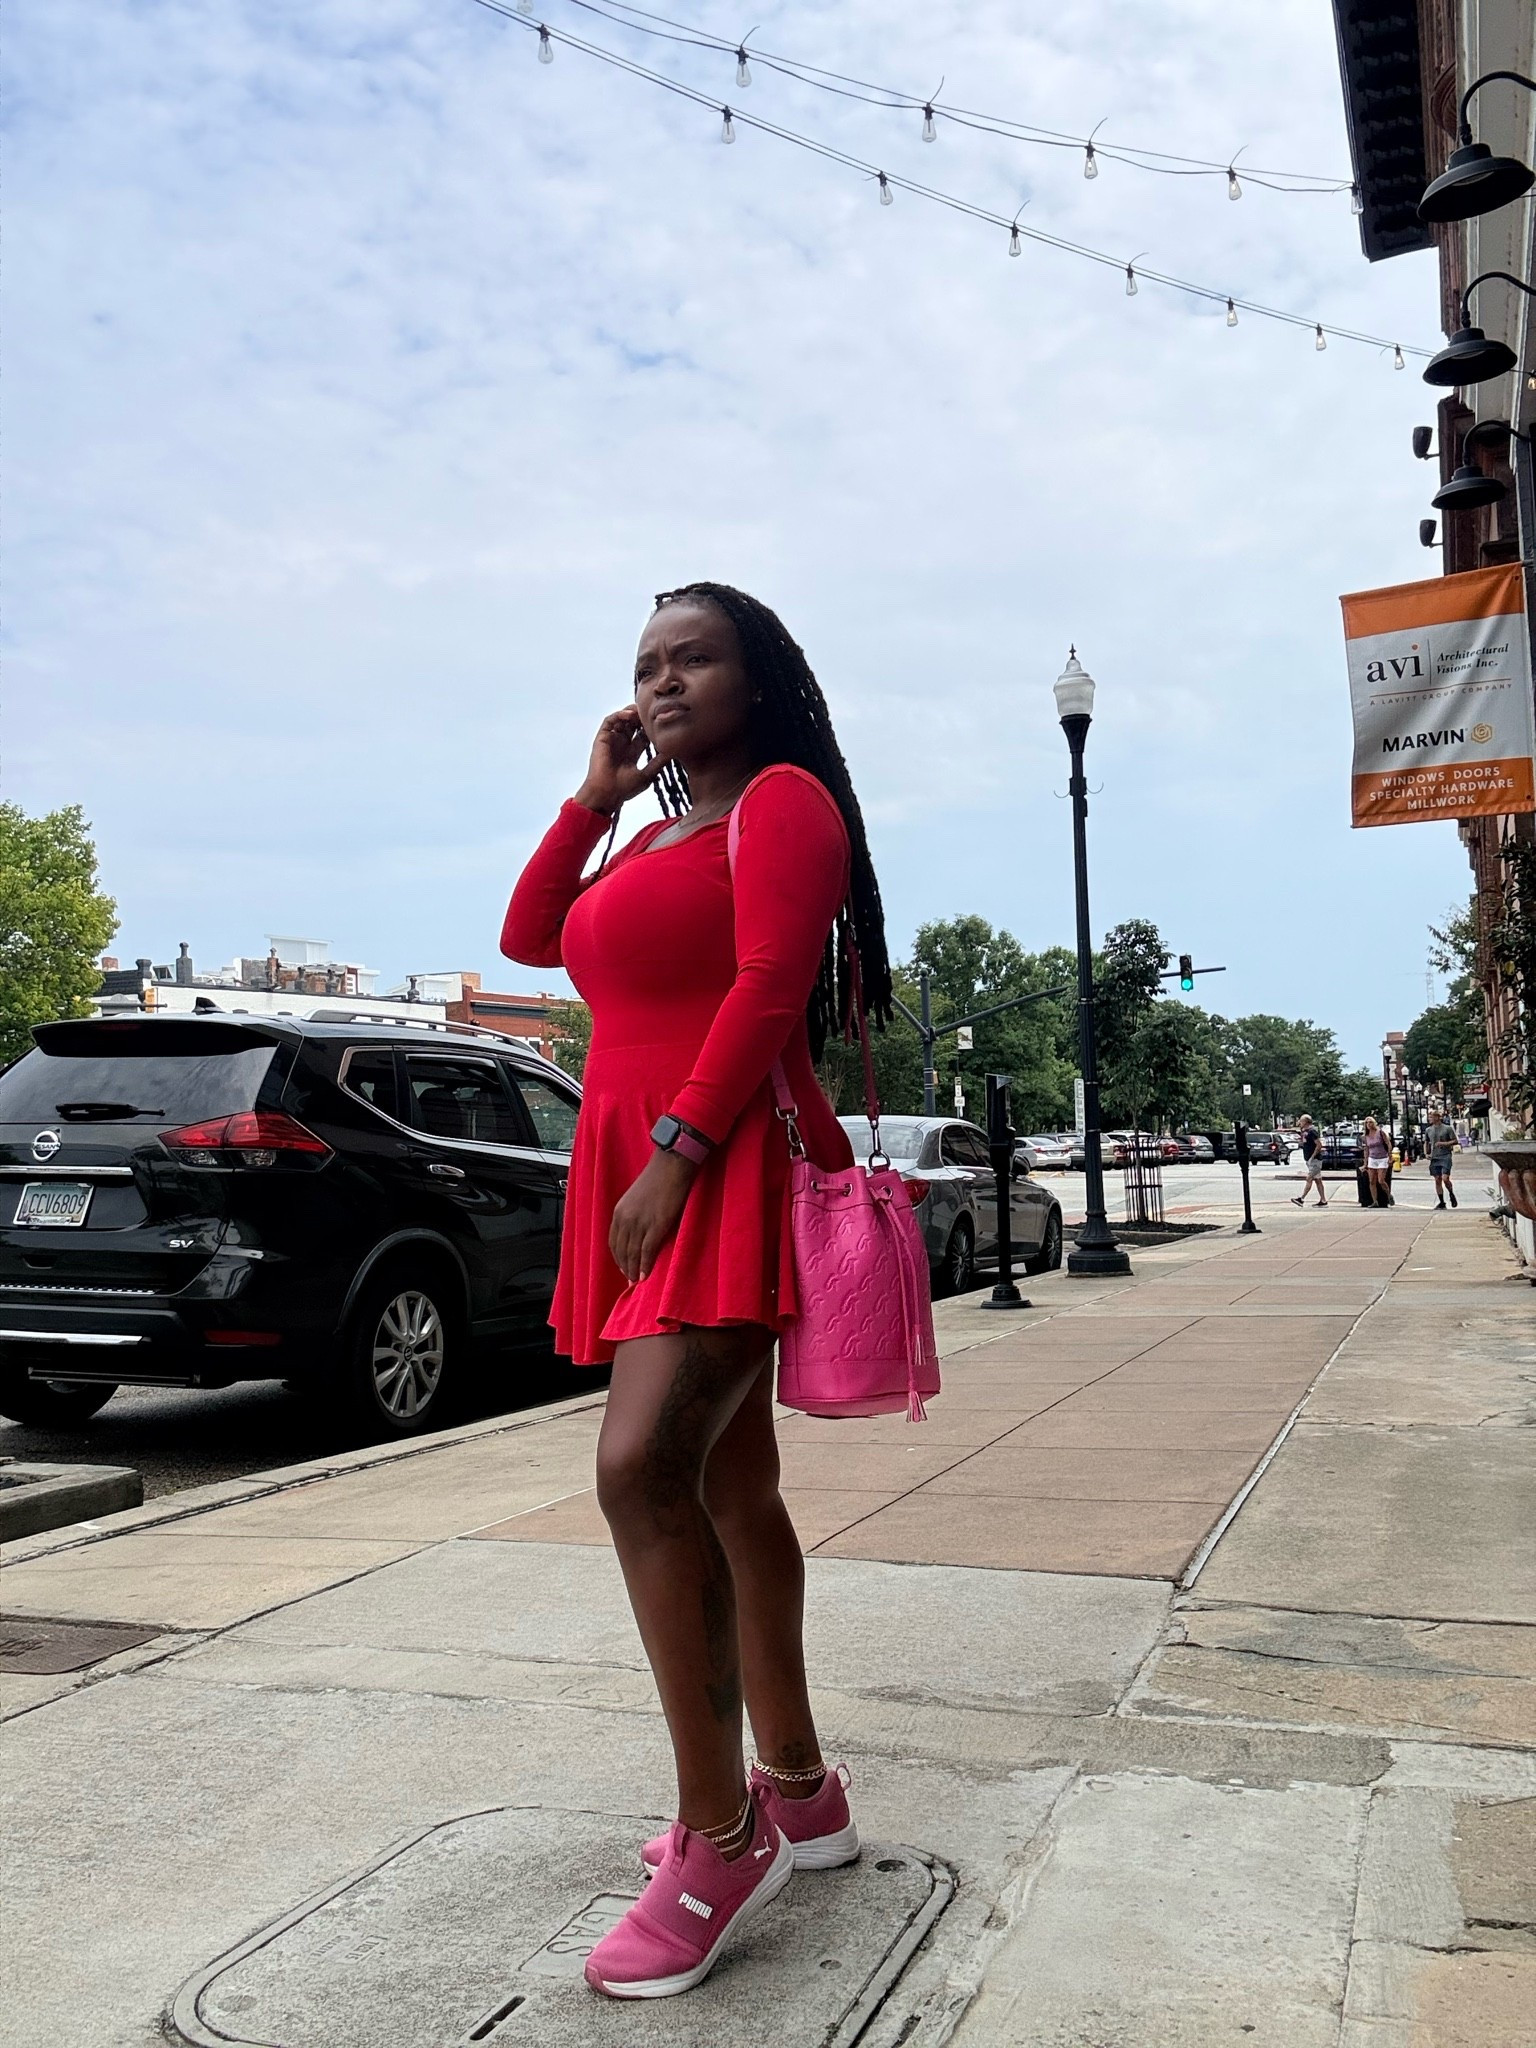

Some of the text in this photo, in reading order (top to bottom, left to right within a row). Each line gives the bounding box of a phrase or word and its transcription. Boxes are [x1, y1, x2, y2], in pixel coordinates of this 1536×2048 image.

[1367, 644, 1424, 683] avi
[1437, 643, 1509, 662] Architectural
[1436, 658, 1498, 675] Visions Inc.
[1422, 689, 1455, 700] GROUP
[1462, 683, 1512, 694] COMPANY
[1382, 728, 1464, 752] MARVIN
[1382, 766, 1500, 788] WINDOWS DOORS
[1369, 778, 1514, 801] SPECIALTY HARDWARE
[1407, 794, 1476, 810] MILLWORK
[28, 1193, 86, 1215] CCV6809
[169, 1239, 194, 1248] SV
[678, 1891, 713, 1920] PUMA
[547, 1911, 625, 1957] GAS
